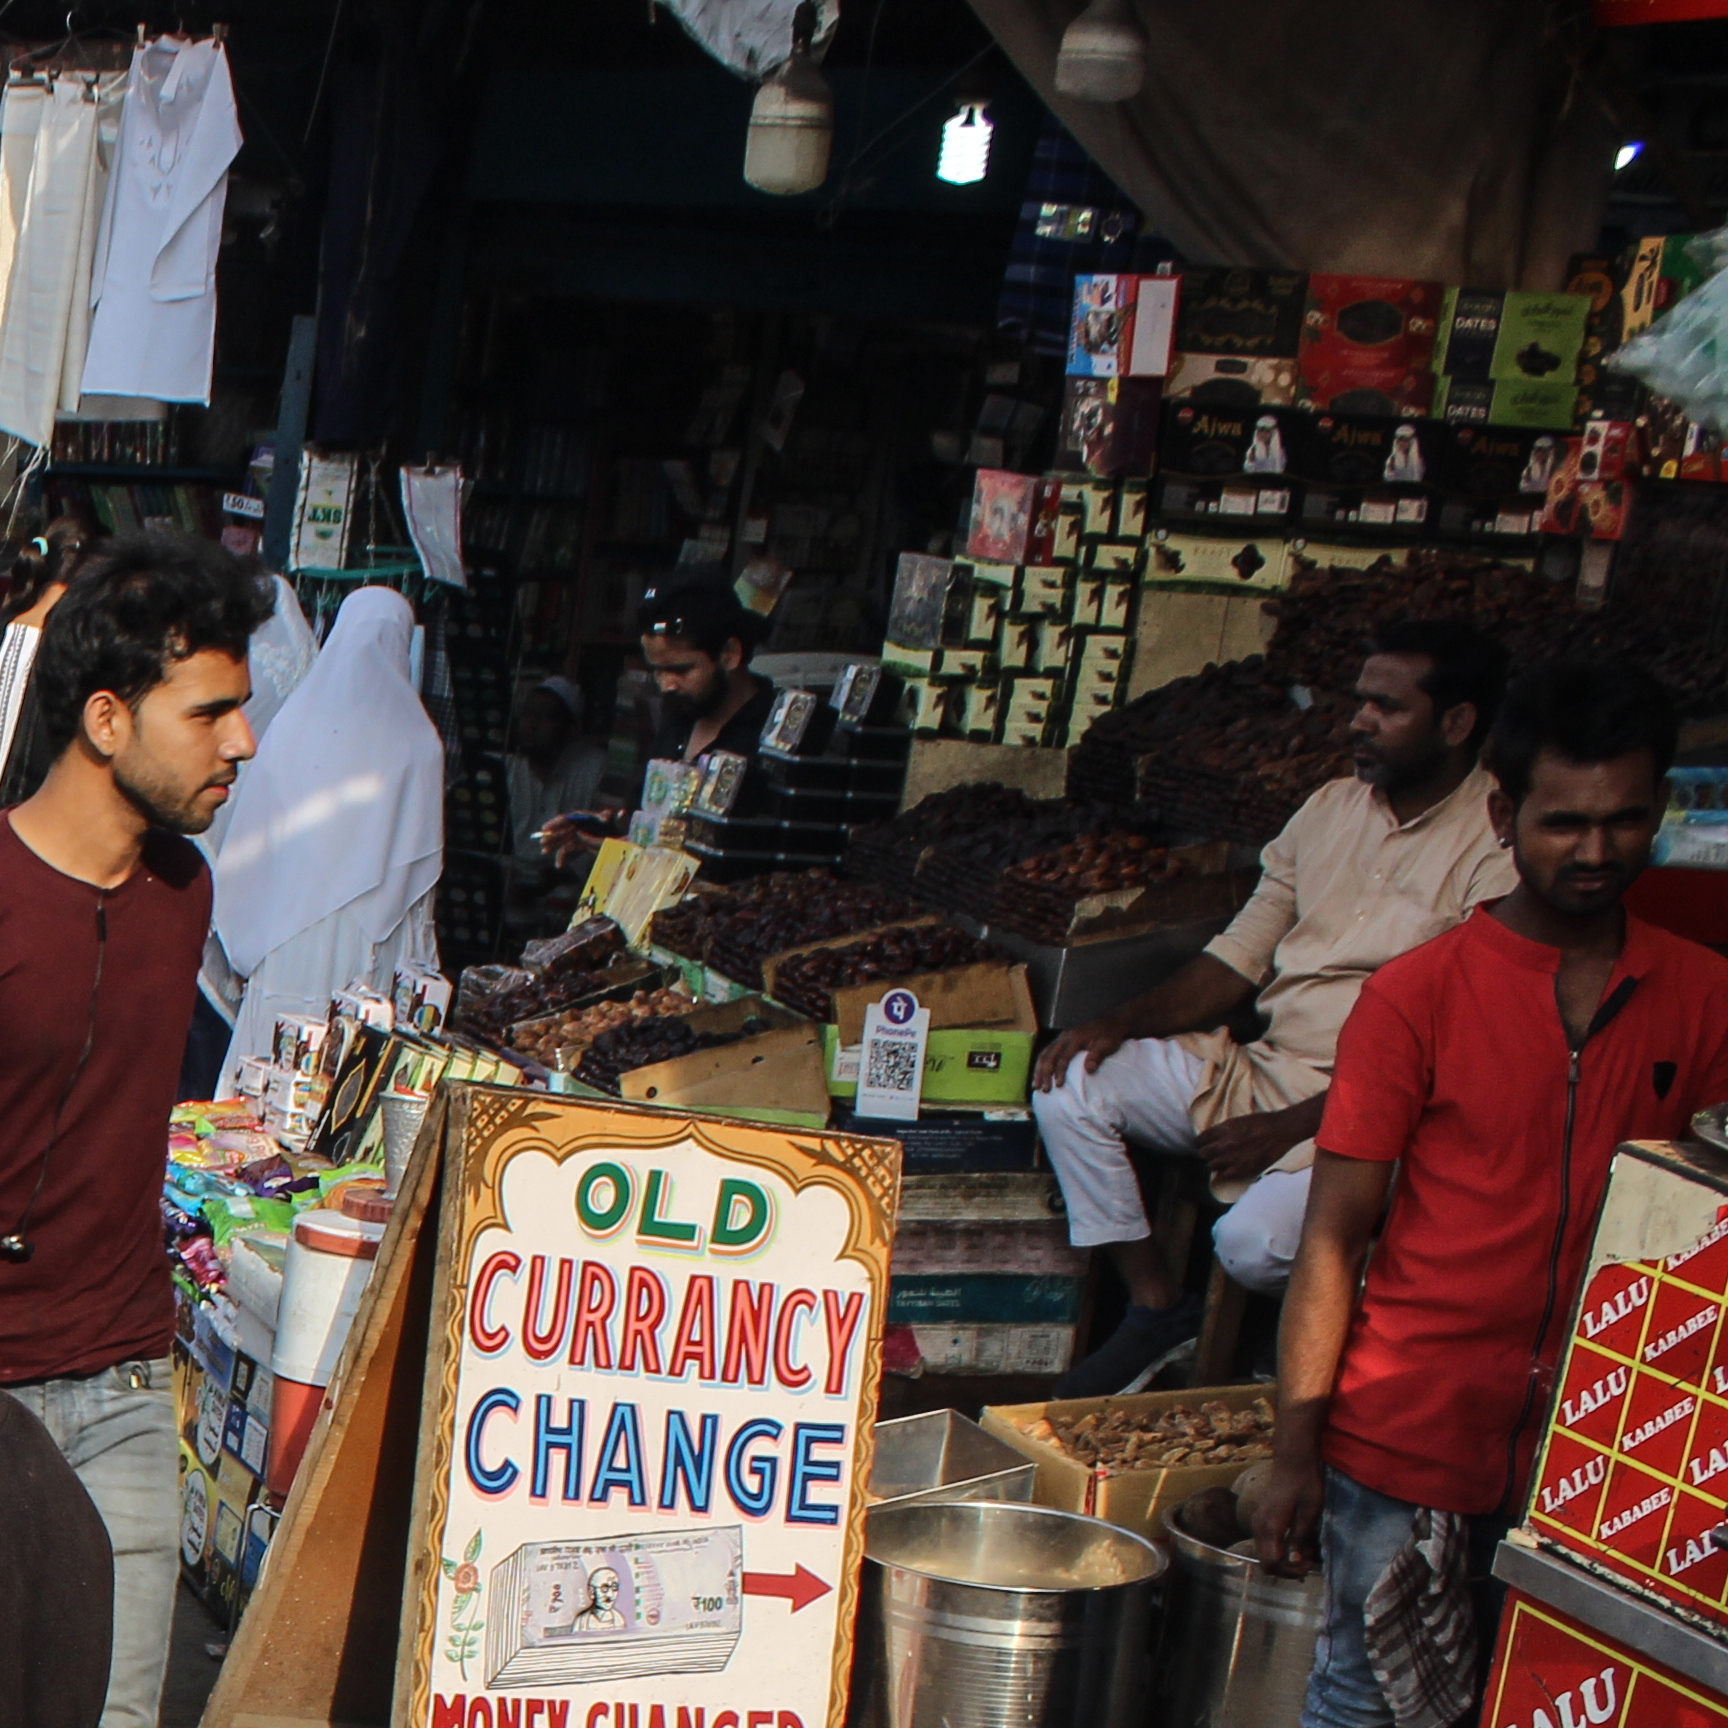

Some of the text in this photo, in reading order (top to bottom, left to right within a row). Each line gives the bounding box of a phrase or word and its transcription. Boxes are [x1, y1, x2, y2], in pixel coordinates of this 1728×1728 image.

[1455, 316, 1497, 332] DATES
[1446, 404, 1487, 420] DATES
[875, 1024, 917, 1039] PhonePe
[575, 1160, 776, 1258] OLD
[468, 1249, 866, 1398] CURRANCY
[1581, 1275, 1650, 1340] LALU
[1643, 1304, 1719, 1364] KABABEE
[1561, 1365, 1629, 1428] LALU
[1621, 1396, 1695, 1453] KABABEE
[465, 1386, 848, 1528] CHANGE
[1540, 1454, 1607, 1516] LALU
[1689, 1438, 1728, 1486] LA
[1599, 1486, 1673, 1541] KABABEE
[1666, 1519, 1728, 1576] LAL
